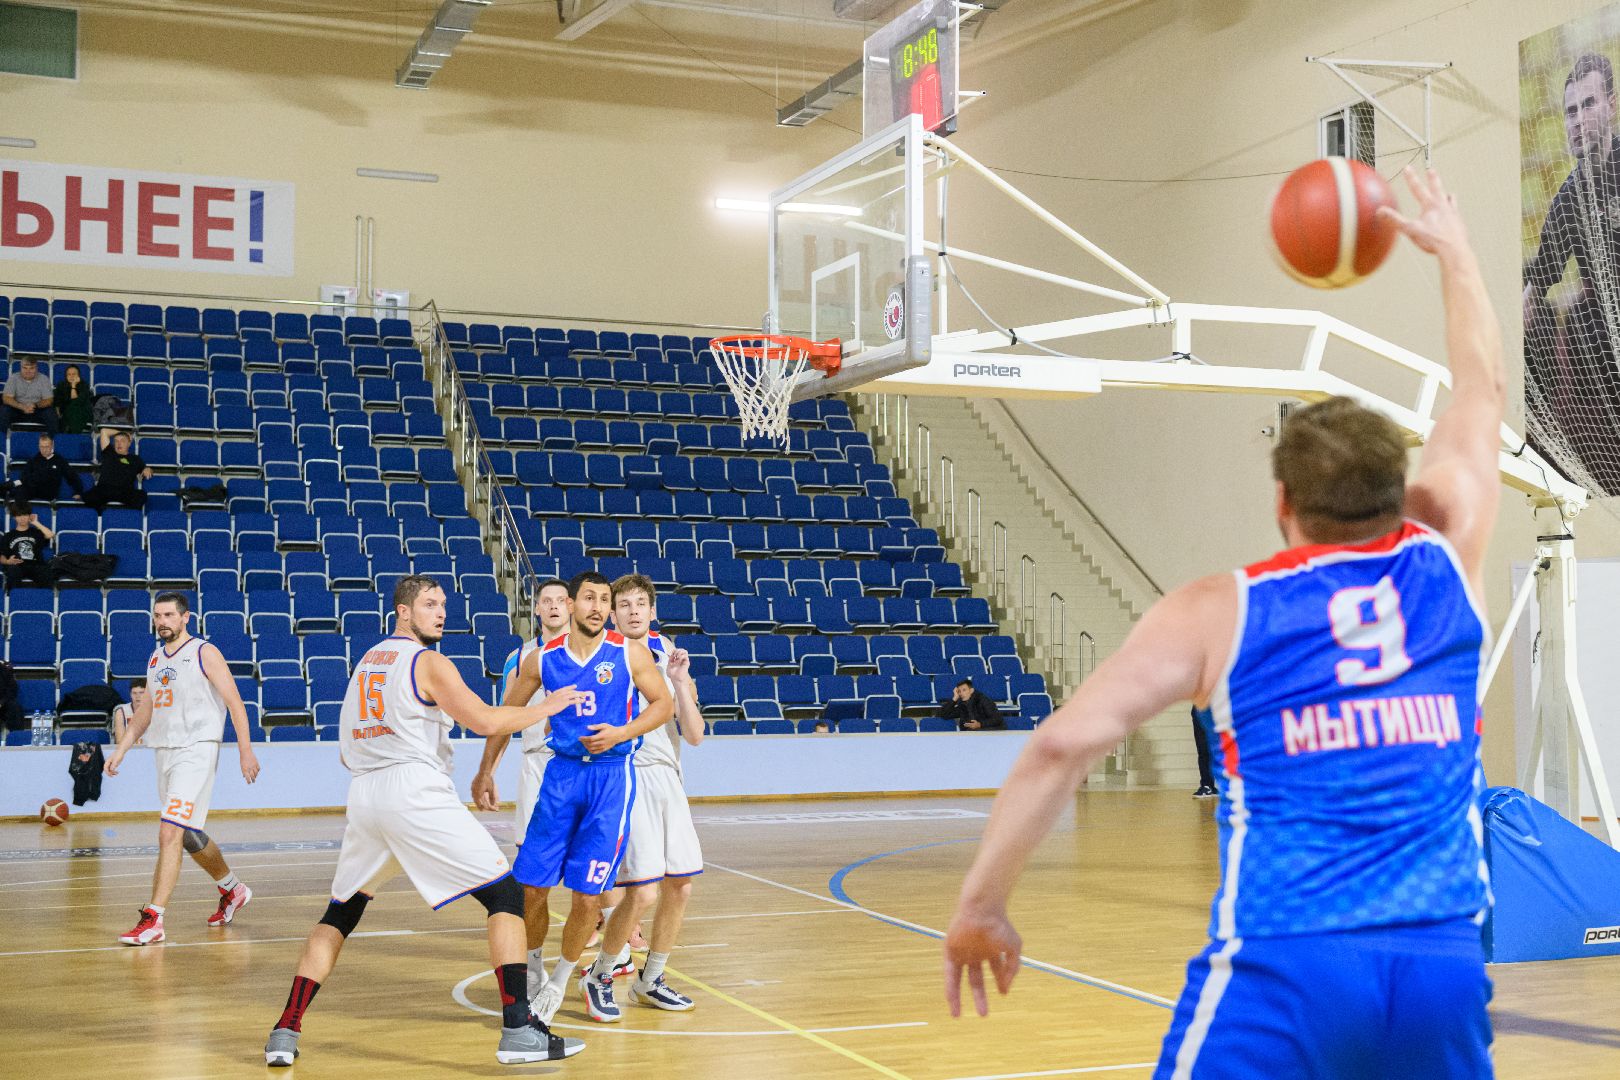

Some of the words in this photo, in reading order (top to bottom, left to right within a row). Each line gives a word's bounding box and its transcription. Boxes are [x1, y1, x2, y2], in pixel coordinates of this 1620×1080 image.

[1, 170, 265, 263] ЬНЕЕ!
[1328, 575, 1413, 686] 9
[154, 689, 173, 708] 23
[357, 671, 387, 721] 15
[1281, 694, 1461, 756] МЫТИЩИ
[166, 798, 195, 820] 23
[586, 859, 611, 884] 13
